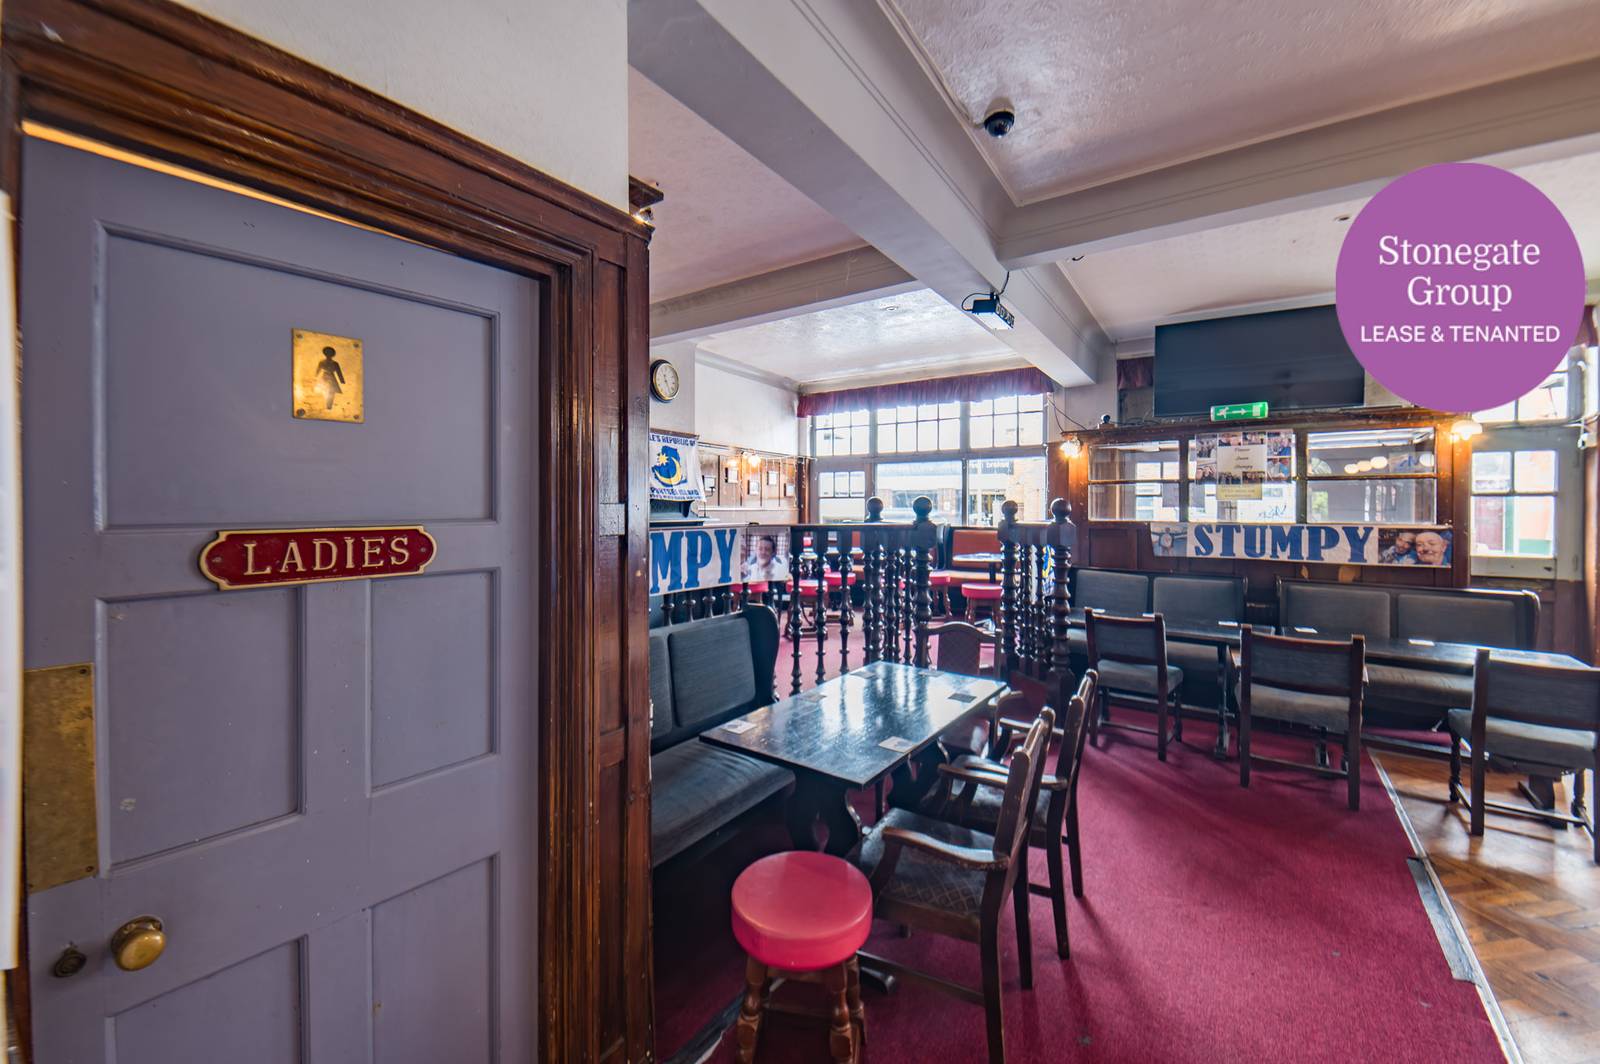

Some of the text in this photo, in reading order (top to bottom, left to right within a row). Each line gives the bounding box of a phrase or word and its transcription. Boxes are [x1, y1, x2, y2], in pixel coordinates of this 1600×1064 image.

[243, 536, 410, 576] LADIES
[650, 529, 737, 594] MPY
[1194, 523, 1374, 563] STUMPY
